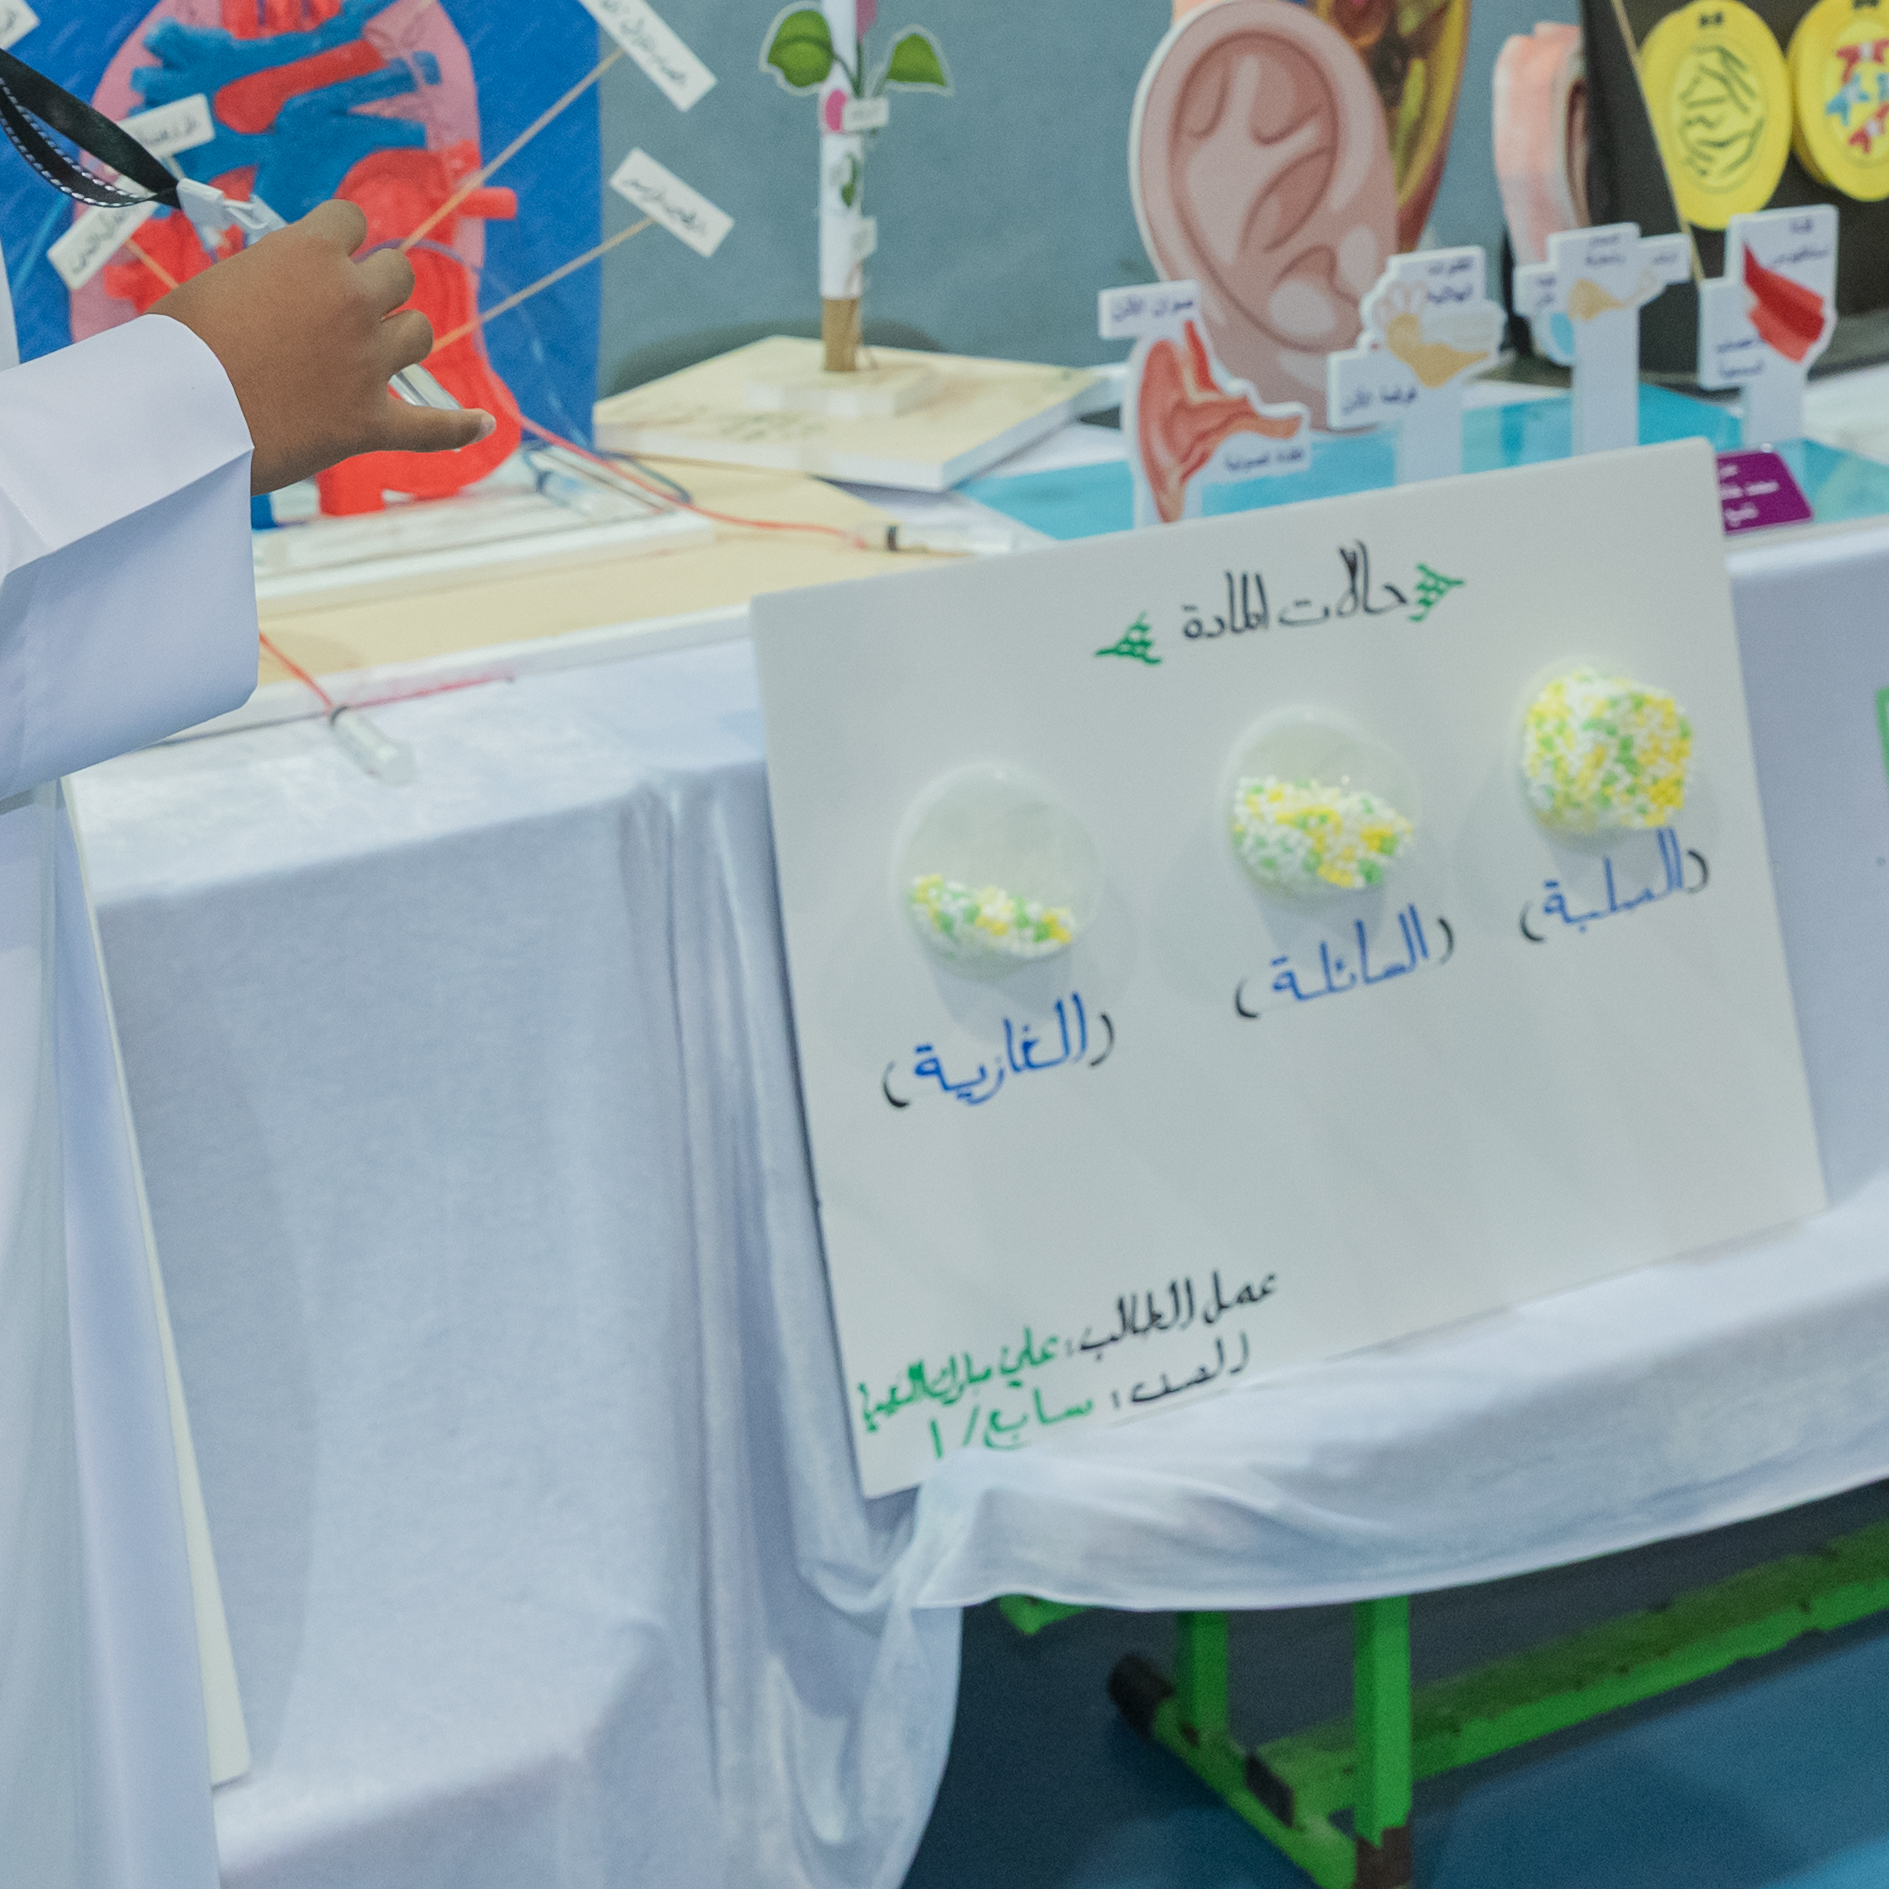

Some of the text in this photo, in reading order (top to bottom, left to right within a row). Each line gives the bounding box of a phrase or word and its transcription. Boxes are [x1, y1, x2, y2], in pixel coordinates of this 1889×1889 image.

[1180, 538, 1410, 642] حالات المادة
[1202, 1268, 1278, 1326] عمل
